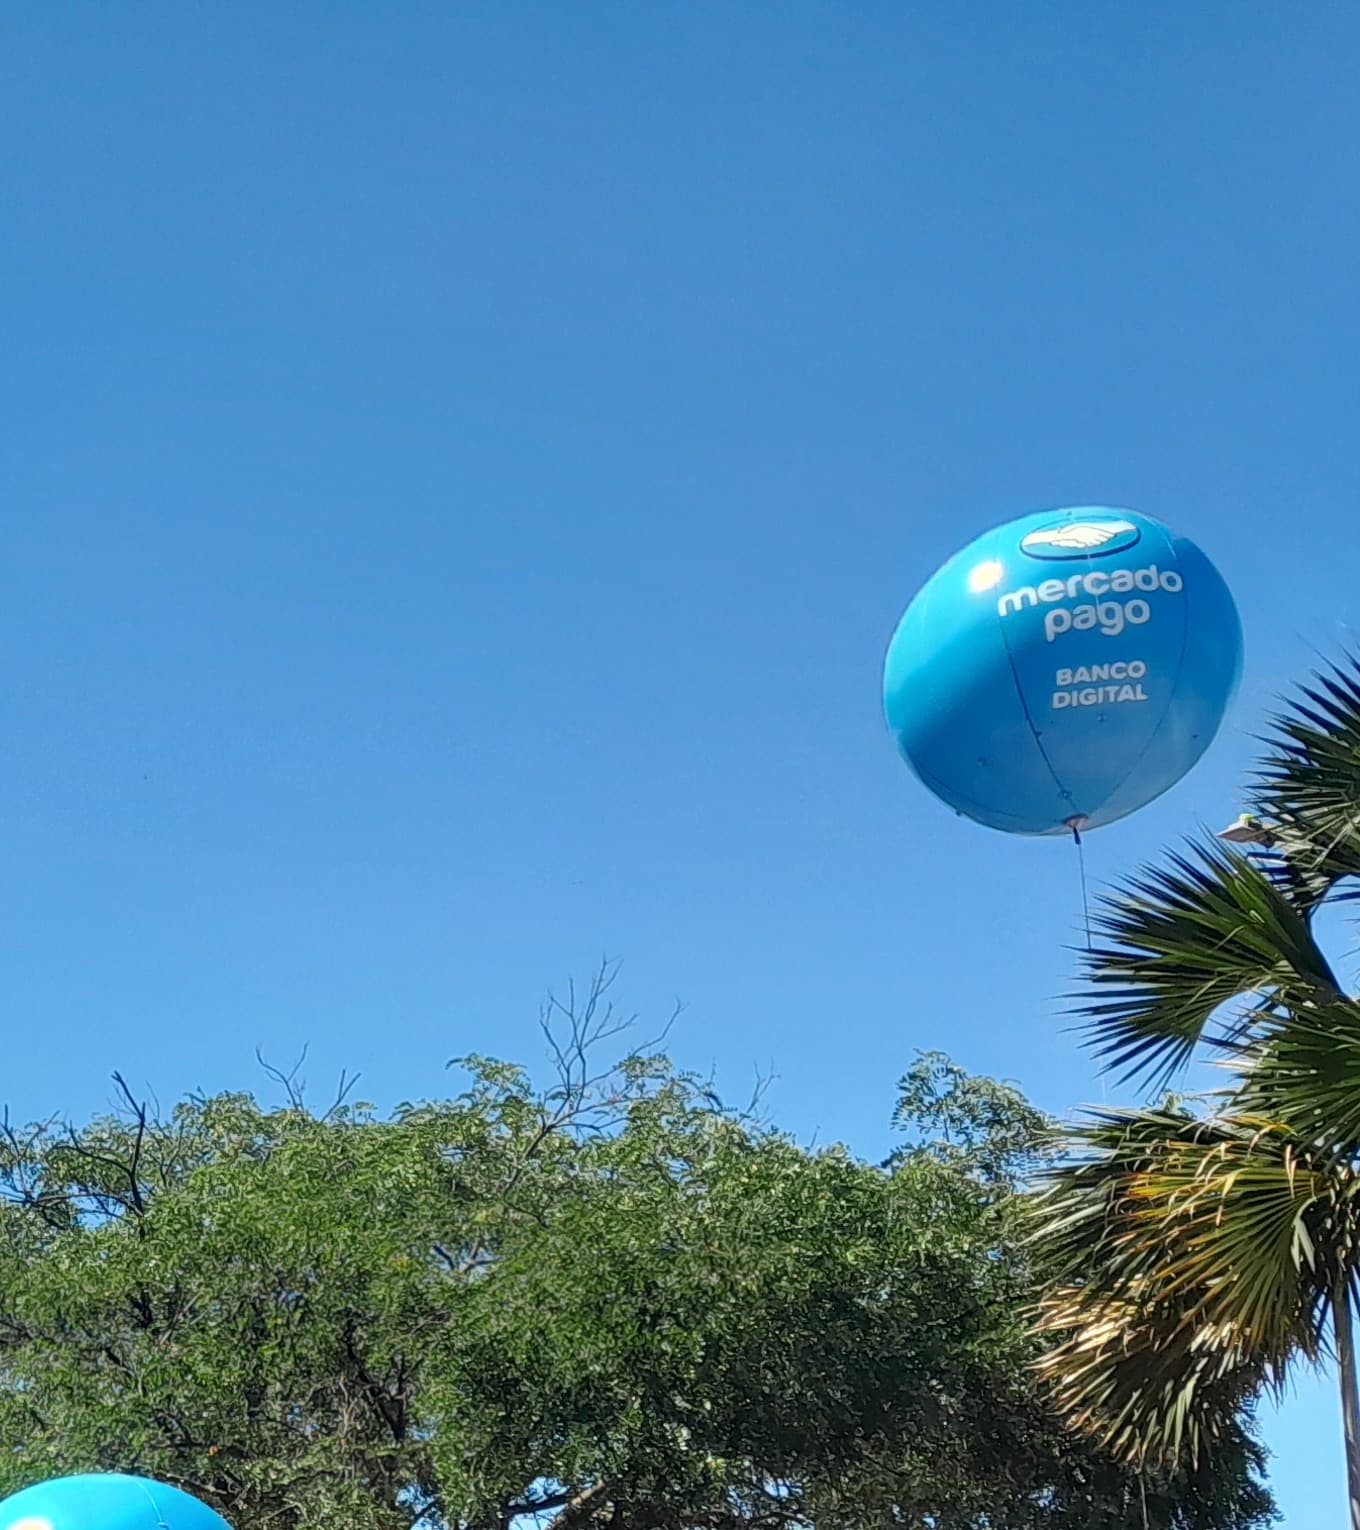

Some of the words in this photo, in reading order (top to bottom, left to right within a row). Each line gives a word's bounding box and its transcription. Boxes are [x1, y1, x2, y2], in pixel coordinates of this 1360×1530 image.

[997, 564, 1184, 617] mercado
[1043, 599, 1151, 642] pago
[1056, 660, 1147, 686] BANCO
[1051, 684, 1148, 709] DIGITAL
